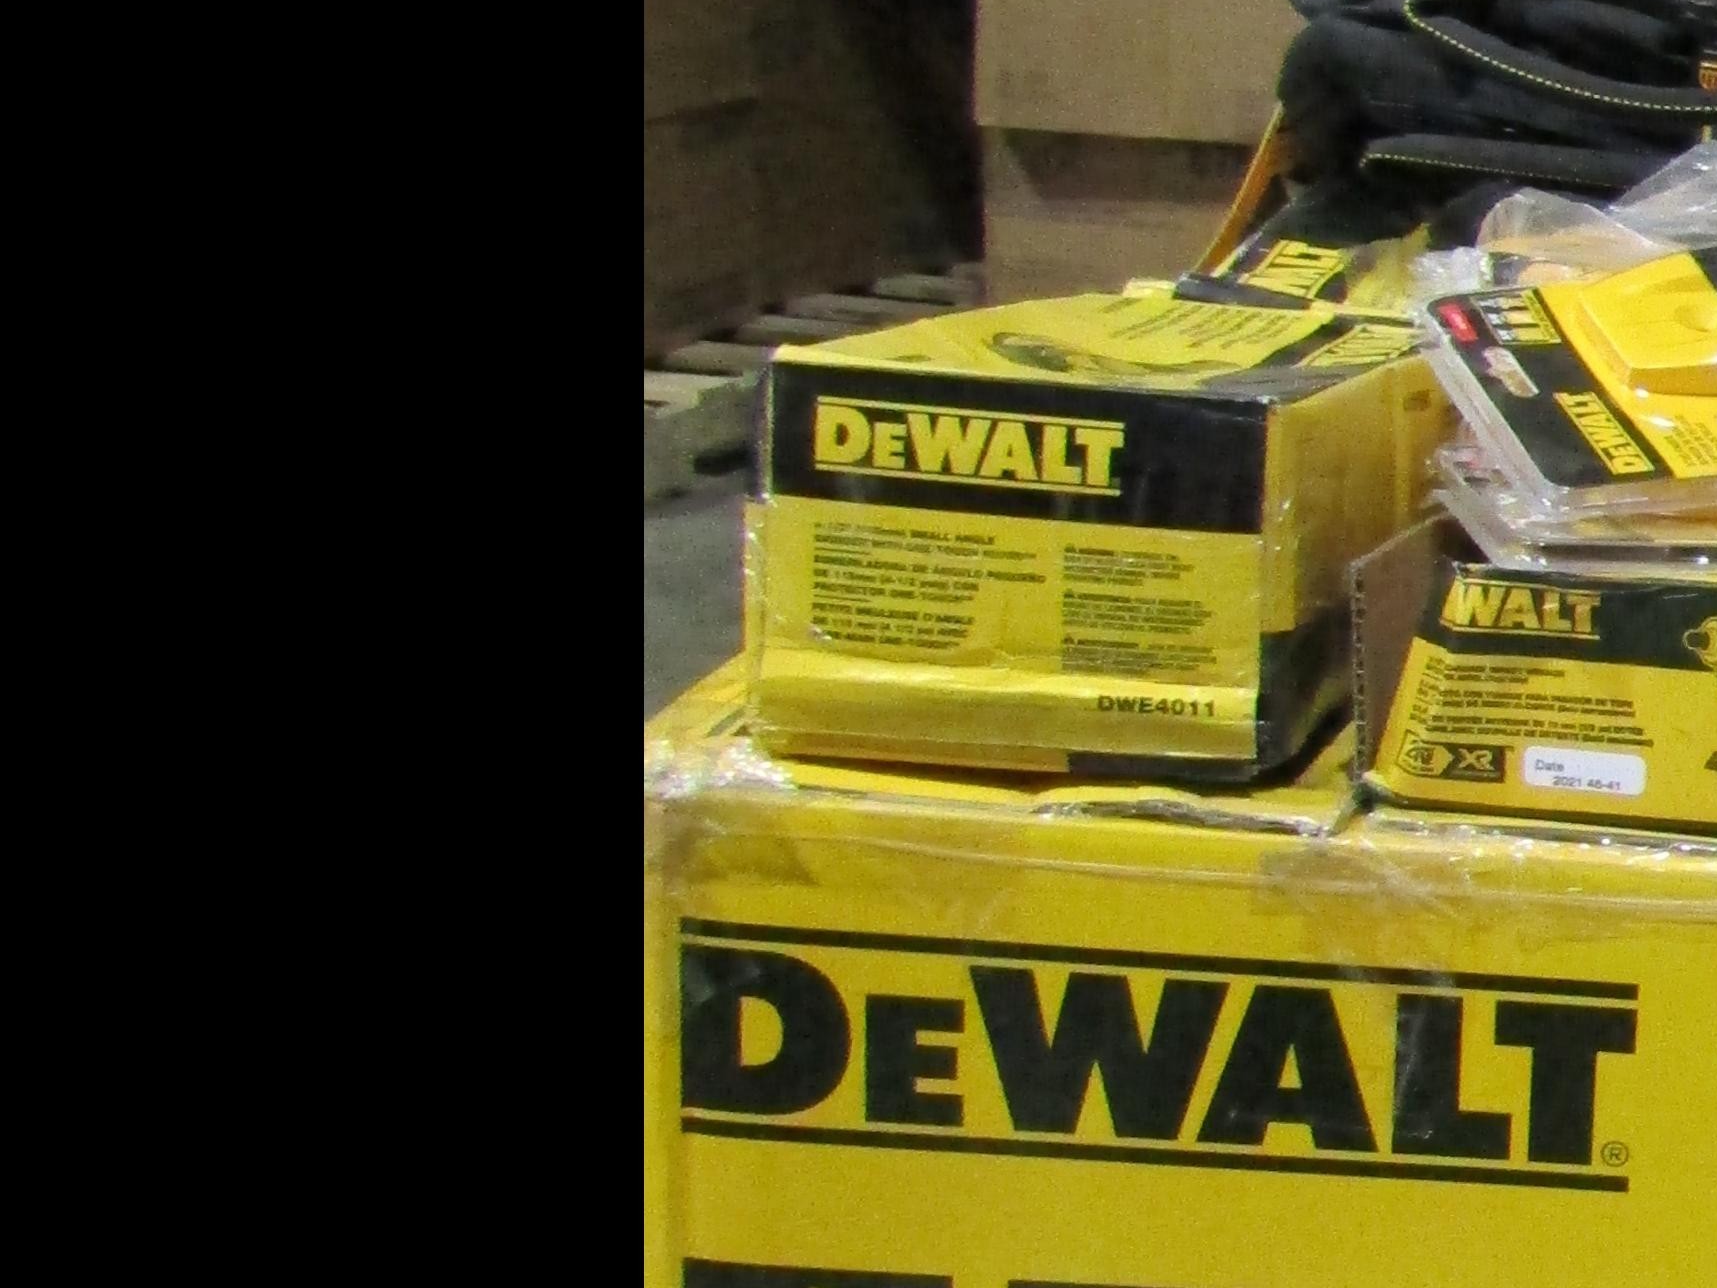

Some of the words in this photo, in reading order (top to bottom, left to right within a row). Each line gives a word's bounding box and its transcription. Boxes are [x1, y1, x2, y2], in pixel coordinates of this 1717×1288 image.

[814, 401, 1124, 487] DEWALT
[1098, 695, 1215, 717] DWE4011
[681, 945, 1637, 1166] DEWALT
